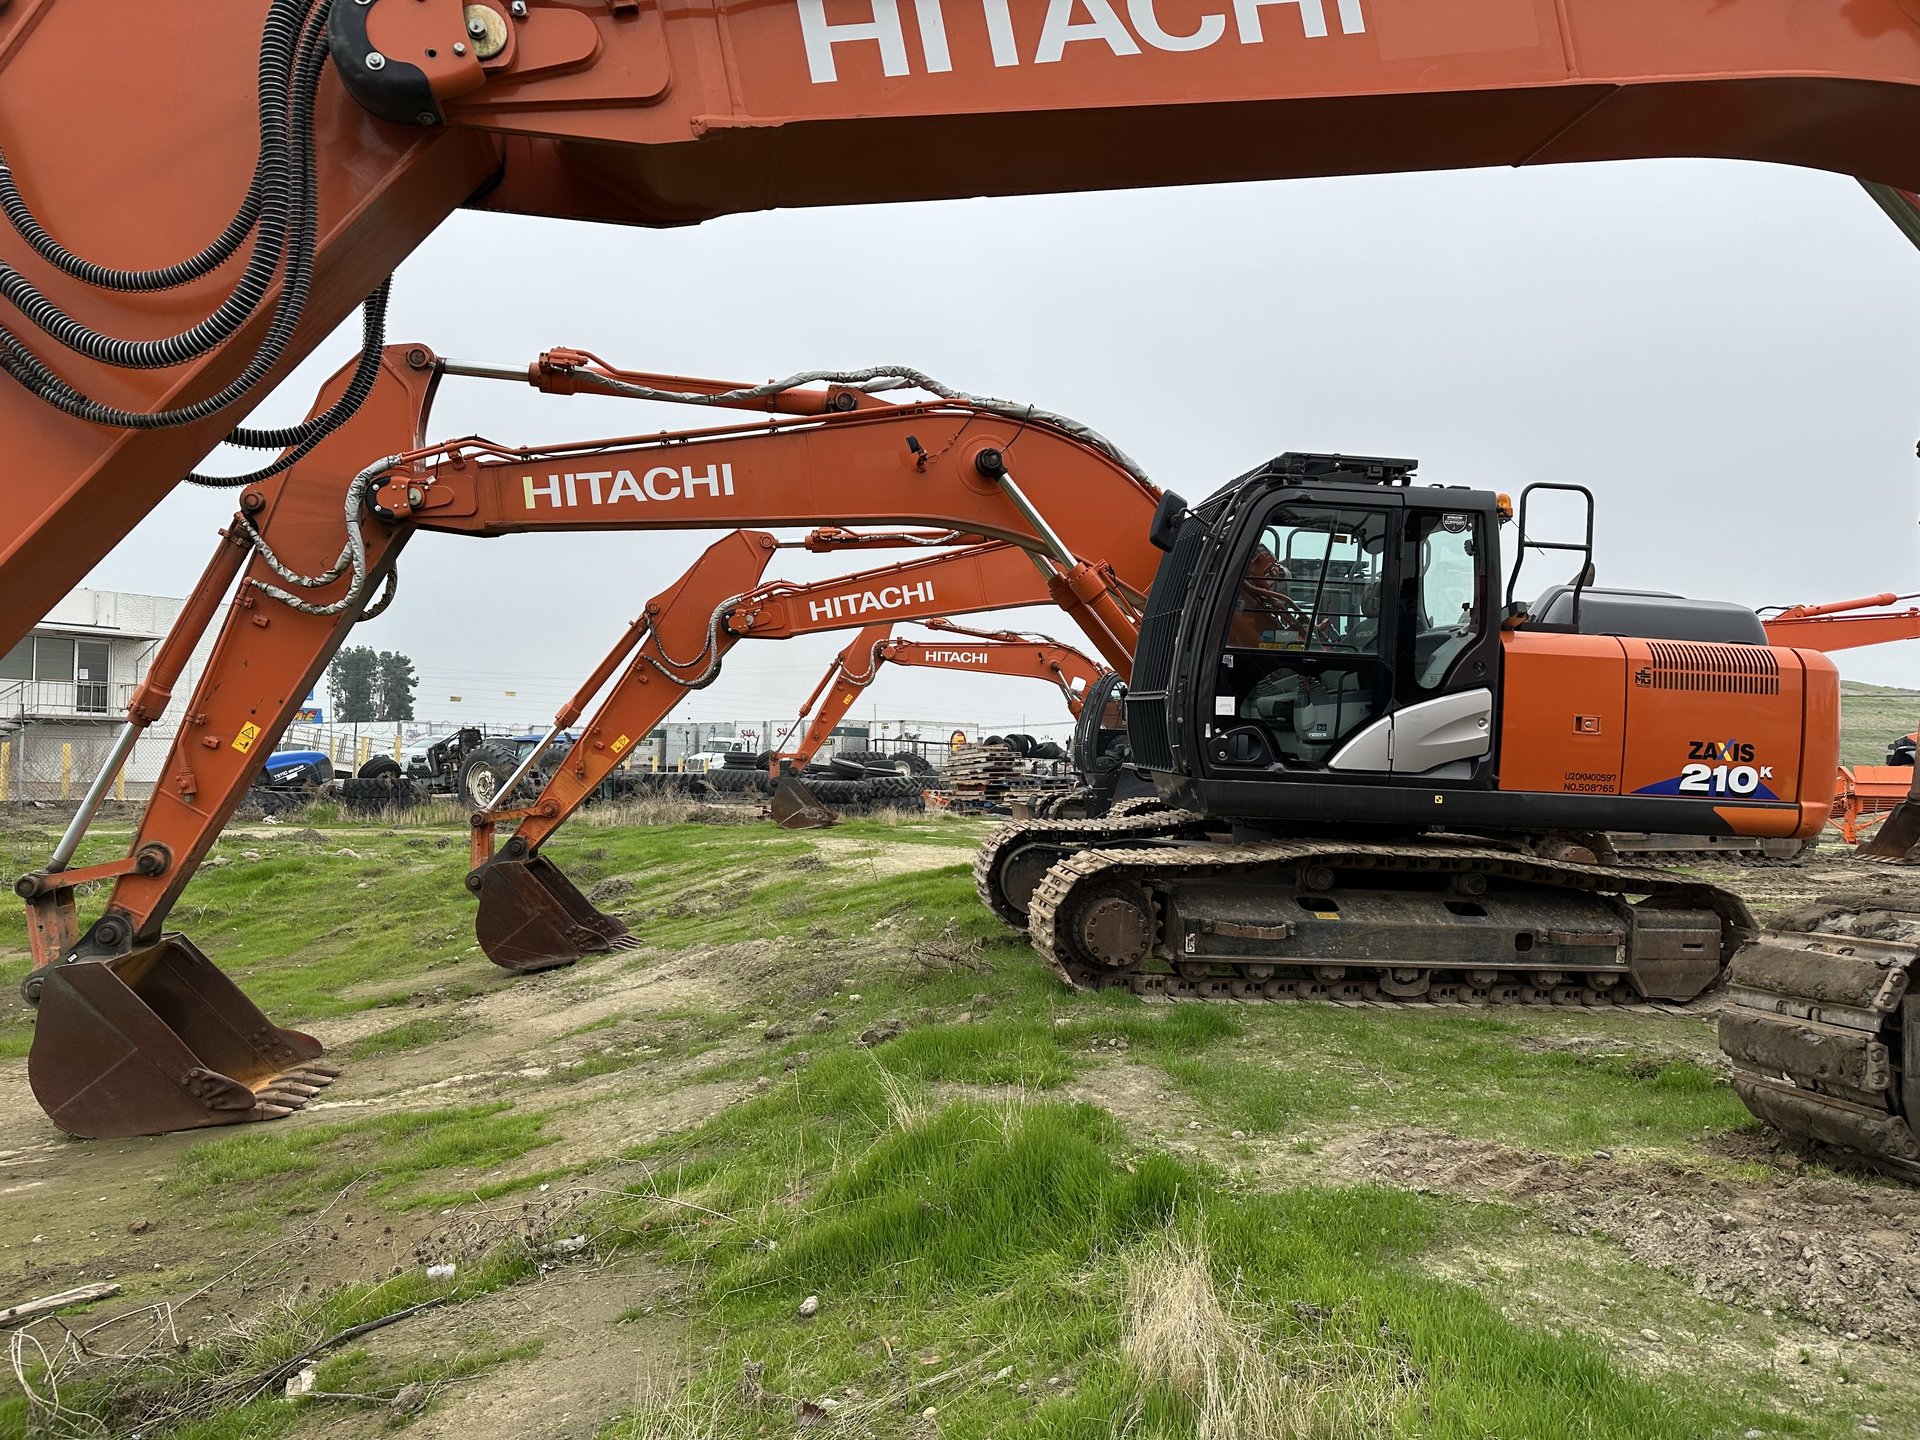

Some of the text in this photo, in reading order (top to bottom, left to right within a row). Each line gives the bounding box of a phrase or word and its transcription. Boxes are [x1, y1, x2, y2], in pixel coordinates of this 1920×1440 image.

[522, 463, 735, 510] HITACHI
[808, 580, 935, 621] HITACHI
[925, 650, 988, 664] HITACHI
[1688, 739, 1755, 762] ZAXIS
[1564, 772, 1617, 782] U20KM00597
[1563, 784, 1615, 793] NO.508765
